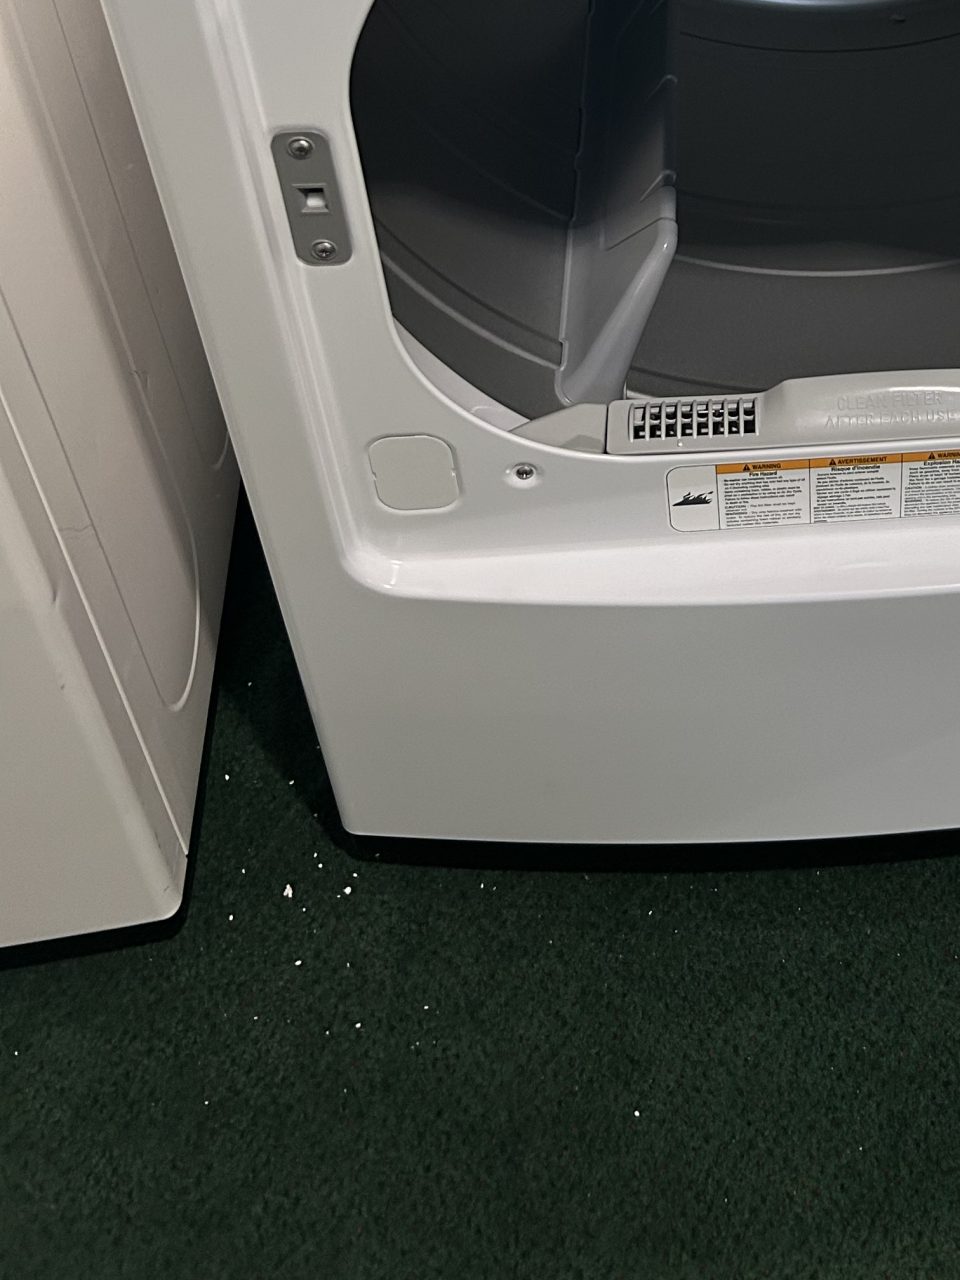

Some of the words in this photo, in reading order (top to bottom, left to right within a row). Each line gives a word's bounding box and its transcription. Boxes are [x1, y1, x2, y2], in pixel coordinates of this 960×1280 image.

[836, 394, 888, 412] CLEAN
[892, 390, 943, 408] FILTER
[824, 414, 875, 429] AFTER
[879, 411, 922, 425] EACH
[926, 410, 957, 421] USE
